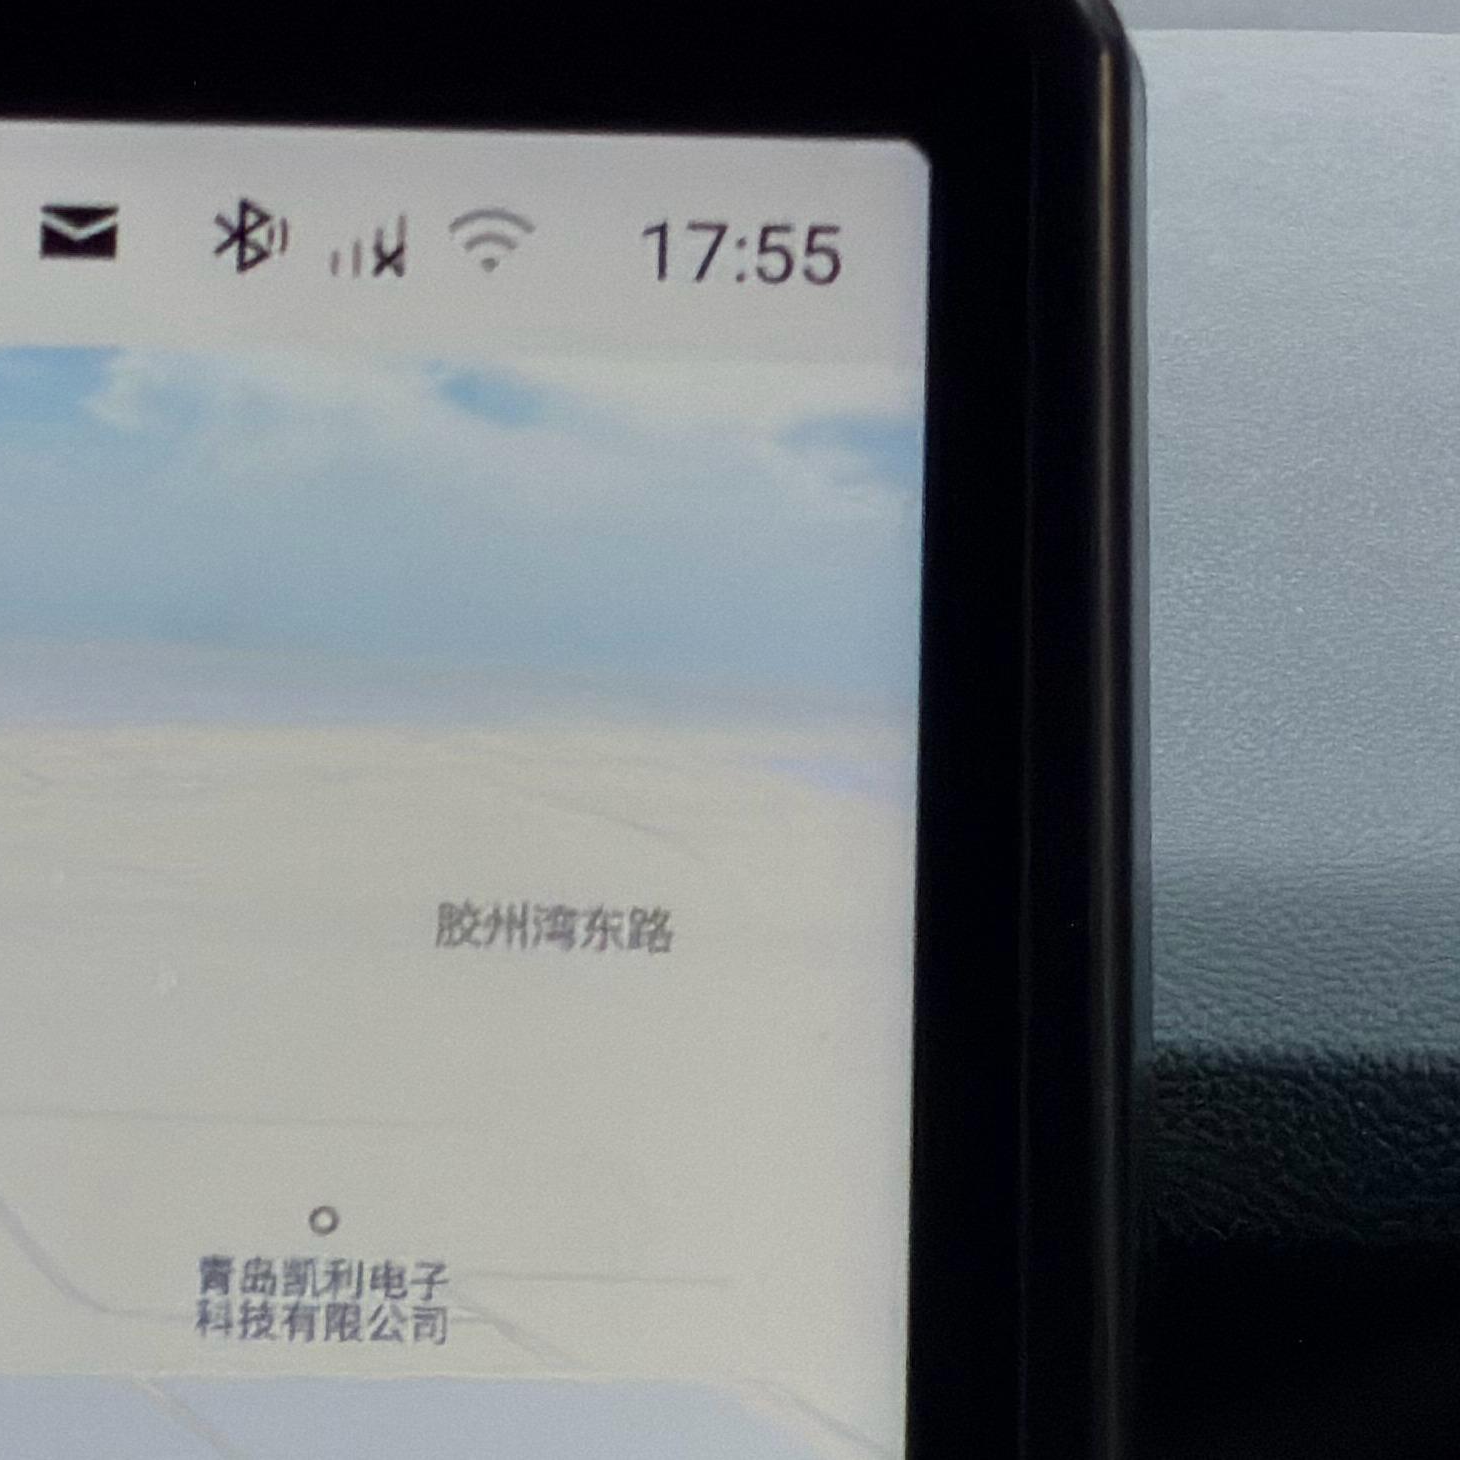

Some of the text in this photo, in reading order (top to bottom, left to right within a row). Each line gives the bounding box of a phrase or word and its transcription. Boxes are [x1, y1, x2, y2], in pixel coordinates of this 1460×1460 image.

[642, 220, 843, 286] 17:55
[435, 899, 675, 955] 胶州湾东路
[198, 1254, 450, 1300] 青岛凯利电子
[195, 1299, 448, 1346] 科技有限公司
